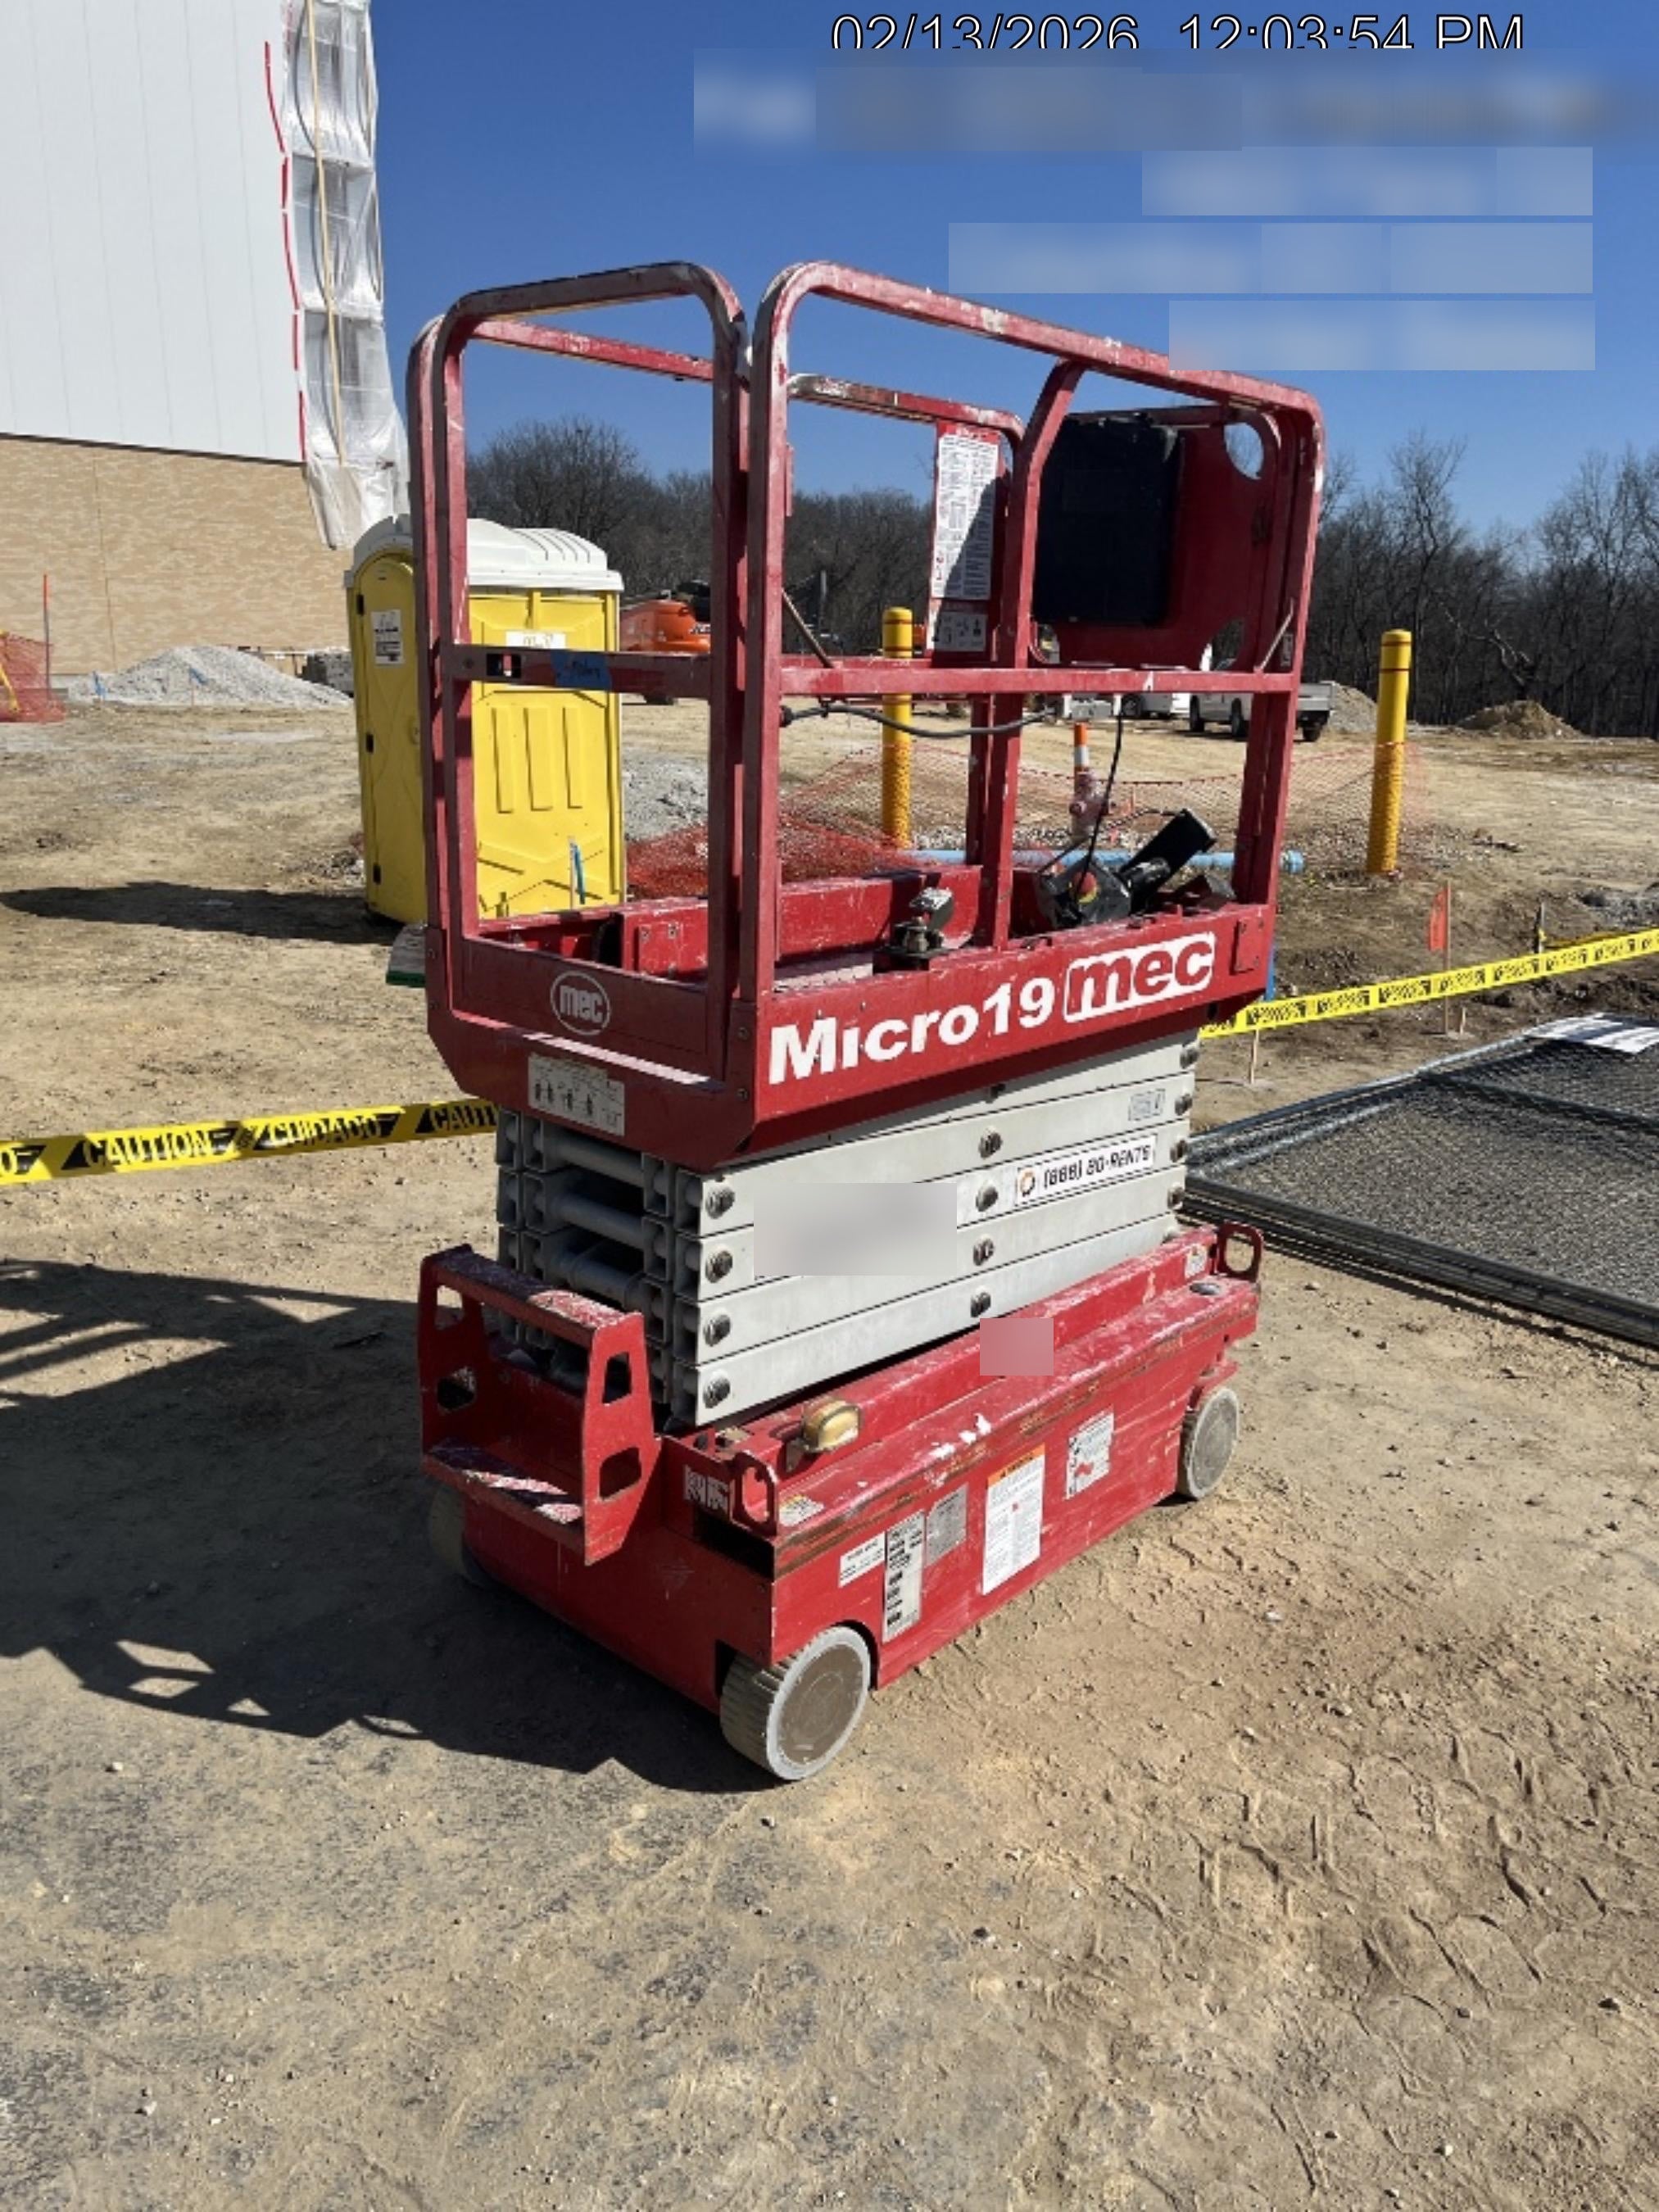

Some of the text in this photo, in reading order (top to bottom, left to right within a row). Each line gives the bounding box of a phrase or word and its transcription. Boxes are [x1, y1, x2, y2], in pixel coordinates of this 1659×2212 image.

[559, 985, 604, 1022] mec
[768, 941, 1213, 1085] Micro19 mec
[84, 1126, 211, 1167] CAUTION
